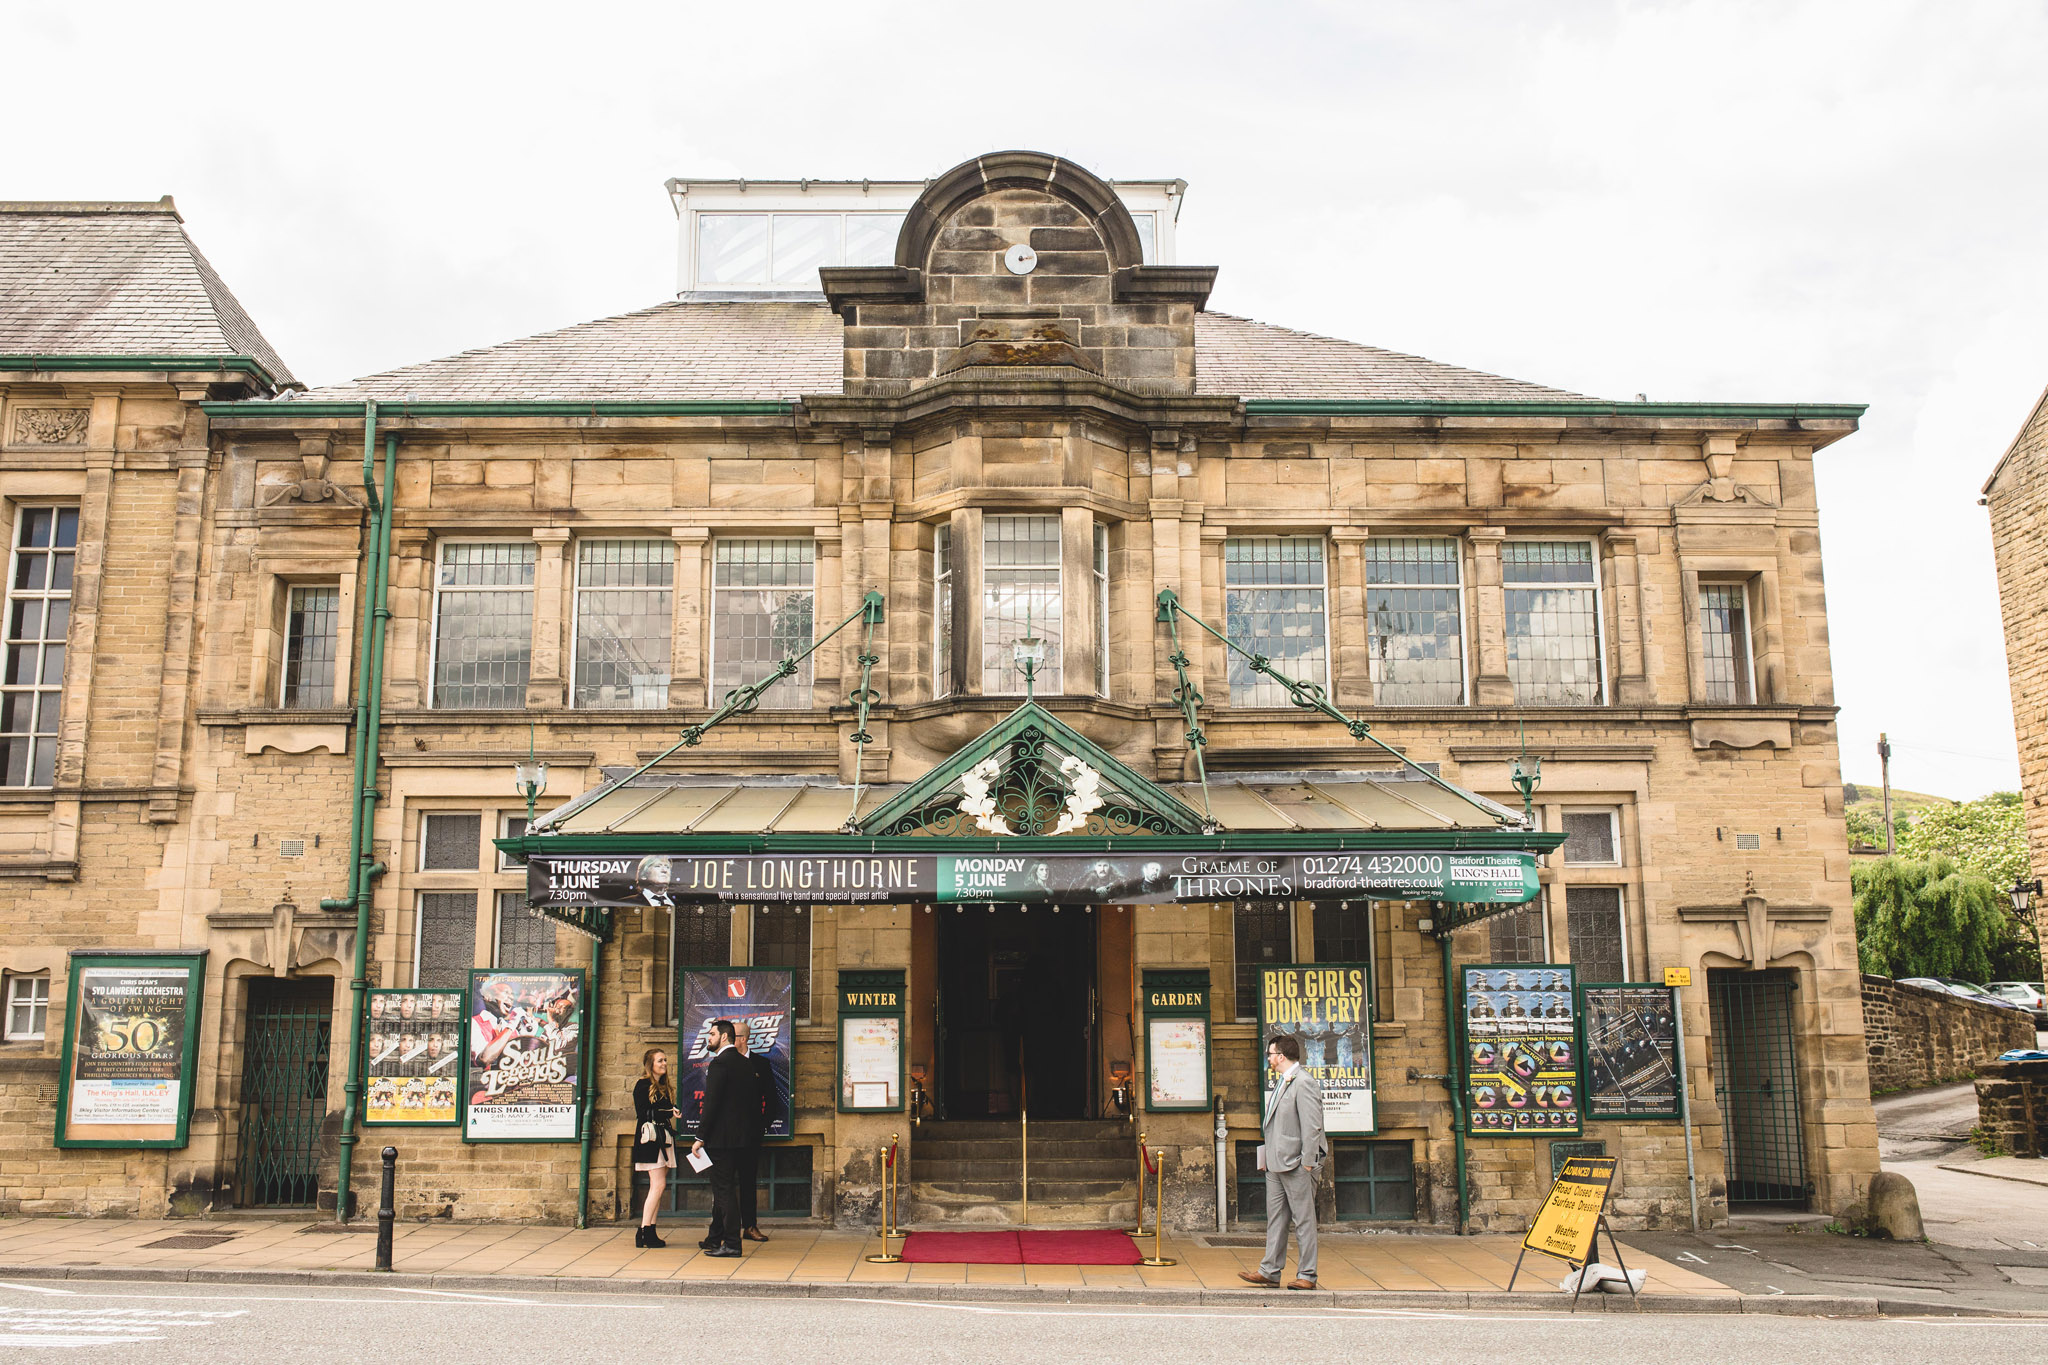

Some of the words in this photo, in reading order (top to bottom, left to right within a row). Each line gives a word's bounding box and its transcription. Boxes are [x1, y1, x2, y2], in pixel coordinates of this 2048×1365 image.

[548, 860, 631, 874] THURSDAY
[955, 859, 1026, 872] MONDAY
[1182, 857, 1250, 874] GRAEME
[1257, 861, 1278, 874] OF
[1303, 856, 1363, 874] 01274
[1368, 856, 1443, 874] 432000
[1450, 856, 1484, 865] Bradford
[1486, 856, 1522, 865] Theatres
[690, 860, 733, 889] JOE
[747, 860, 918, 889] LONGTHORNE
[1454, 868, 1489, 878] KING'S
[1491, 868, 1520, 878] HALL
[549, 875, 558, 889] 1
[561, 875, 600, 889] JUNE
[955, 874, 964, 887] 5
[968, 874, 1006, 887] JUNE
[1169, 874, 1292, 898] THRONES
[1304, 876, 1444, 889] bradford-theatres.co.uk
[548, 890, 587, 902] 7.30pm
[718, 892, 734, 900] With
[743, 892, 779, 900] sensational
[780, 891, 792, 900] live
[794, 891, 810, 900] band
[812, 891, 824, 900] and
[826, 891, 850, 901] special
[850, 892, 870, 901] guest
[871, 891, 889, 900] artist
[955, 888, 993, 898] 7.30pm
[1264, 971, 1298, 998] BIG
[1305, 970, 1362, 998] GIRLS
[92, 986, 105, 996] SYD
[106, 986, 142, 996] LAWRENCE
[144, 986, 183, 996] ORCHESTRA
[847, 993, 897, 1006] WINTER
[1152, 993, 1202, 1006] GARDEN
[1266, 998, 1320, 1024] DON'T
[1325, 997, 1362, 1023] CRY
[106, 1019, 160, 1052] 50
[1330, 1067, 1366, 1079] VALLI
[1324, 1079, 1366, 1087] SEASONS
[1563, 1165, 1590, 1177] ADVANCED
[1555, 1183, 1573, 1195] Road
[1574, 1186, 1593, 1197] Closed
[1552, 1196, 1575, 1209] Surface
[1578, 1200, 1600, 1215] Dressing
[1555, 1224, 1579, 1238] Weather
[1544, 1236, 1576, 1254] Permitting
